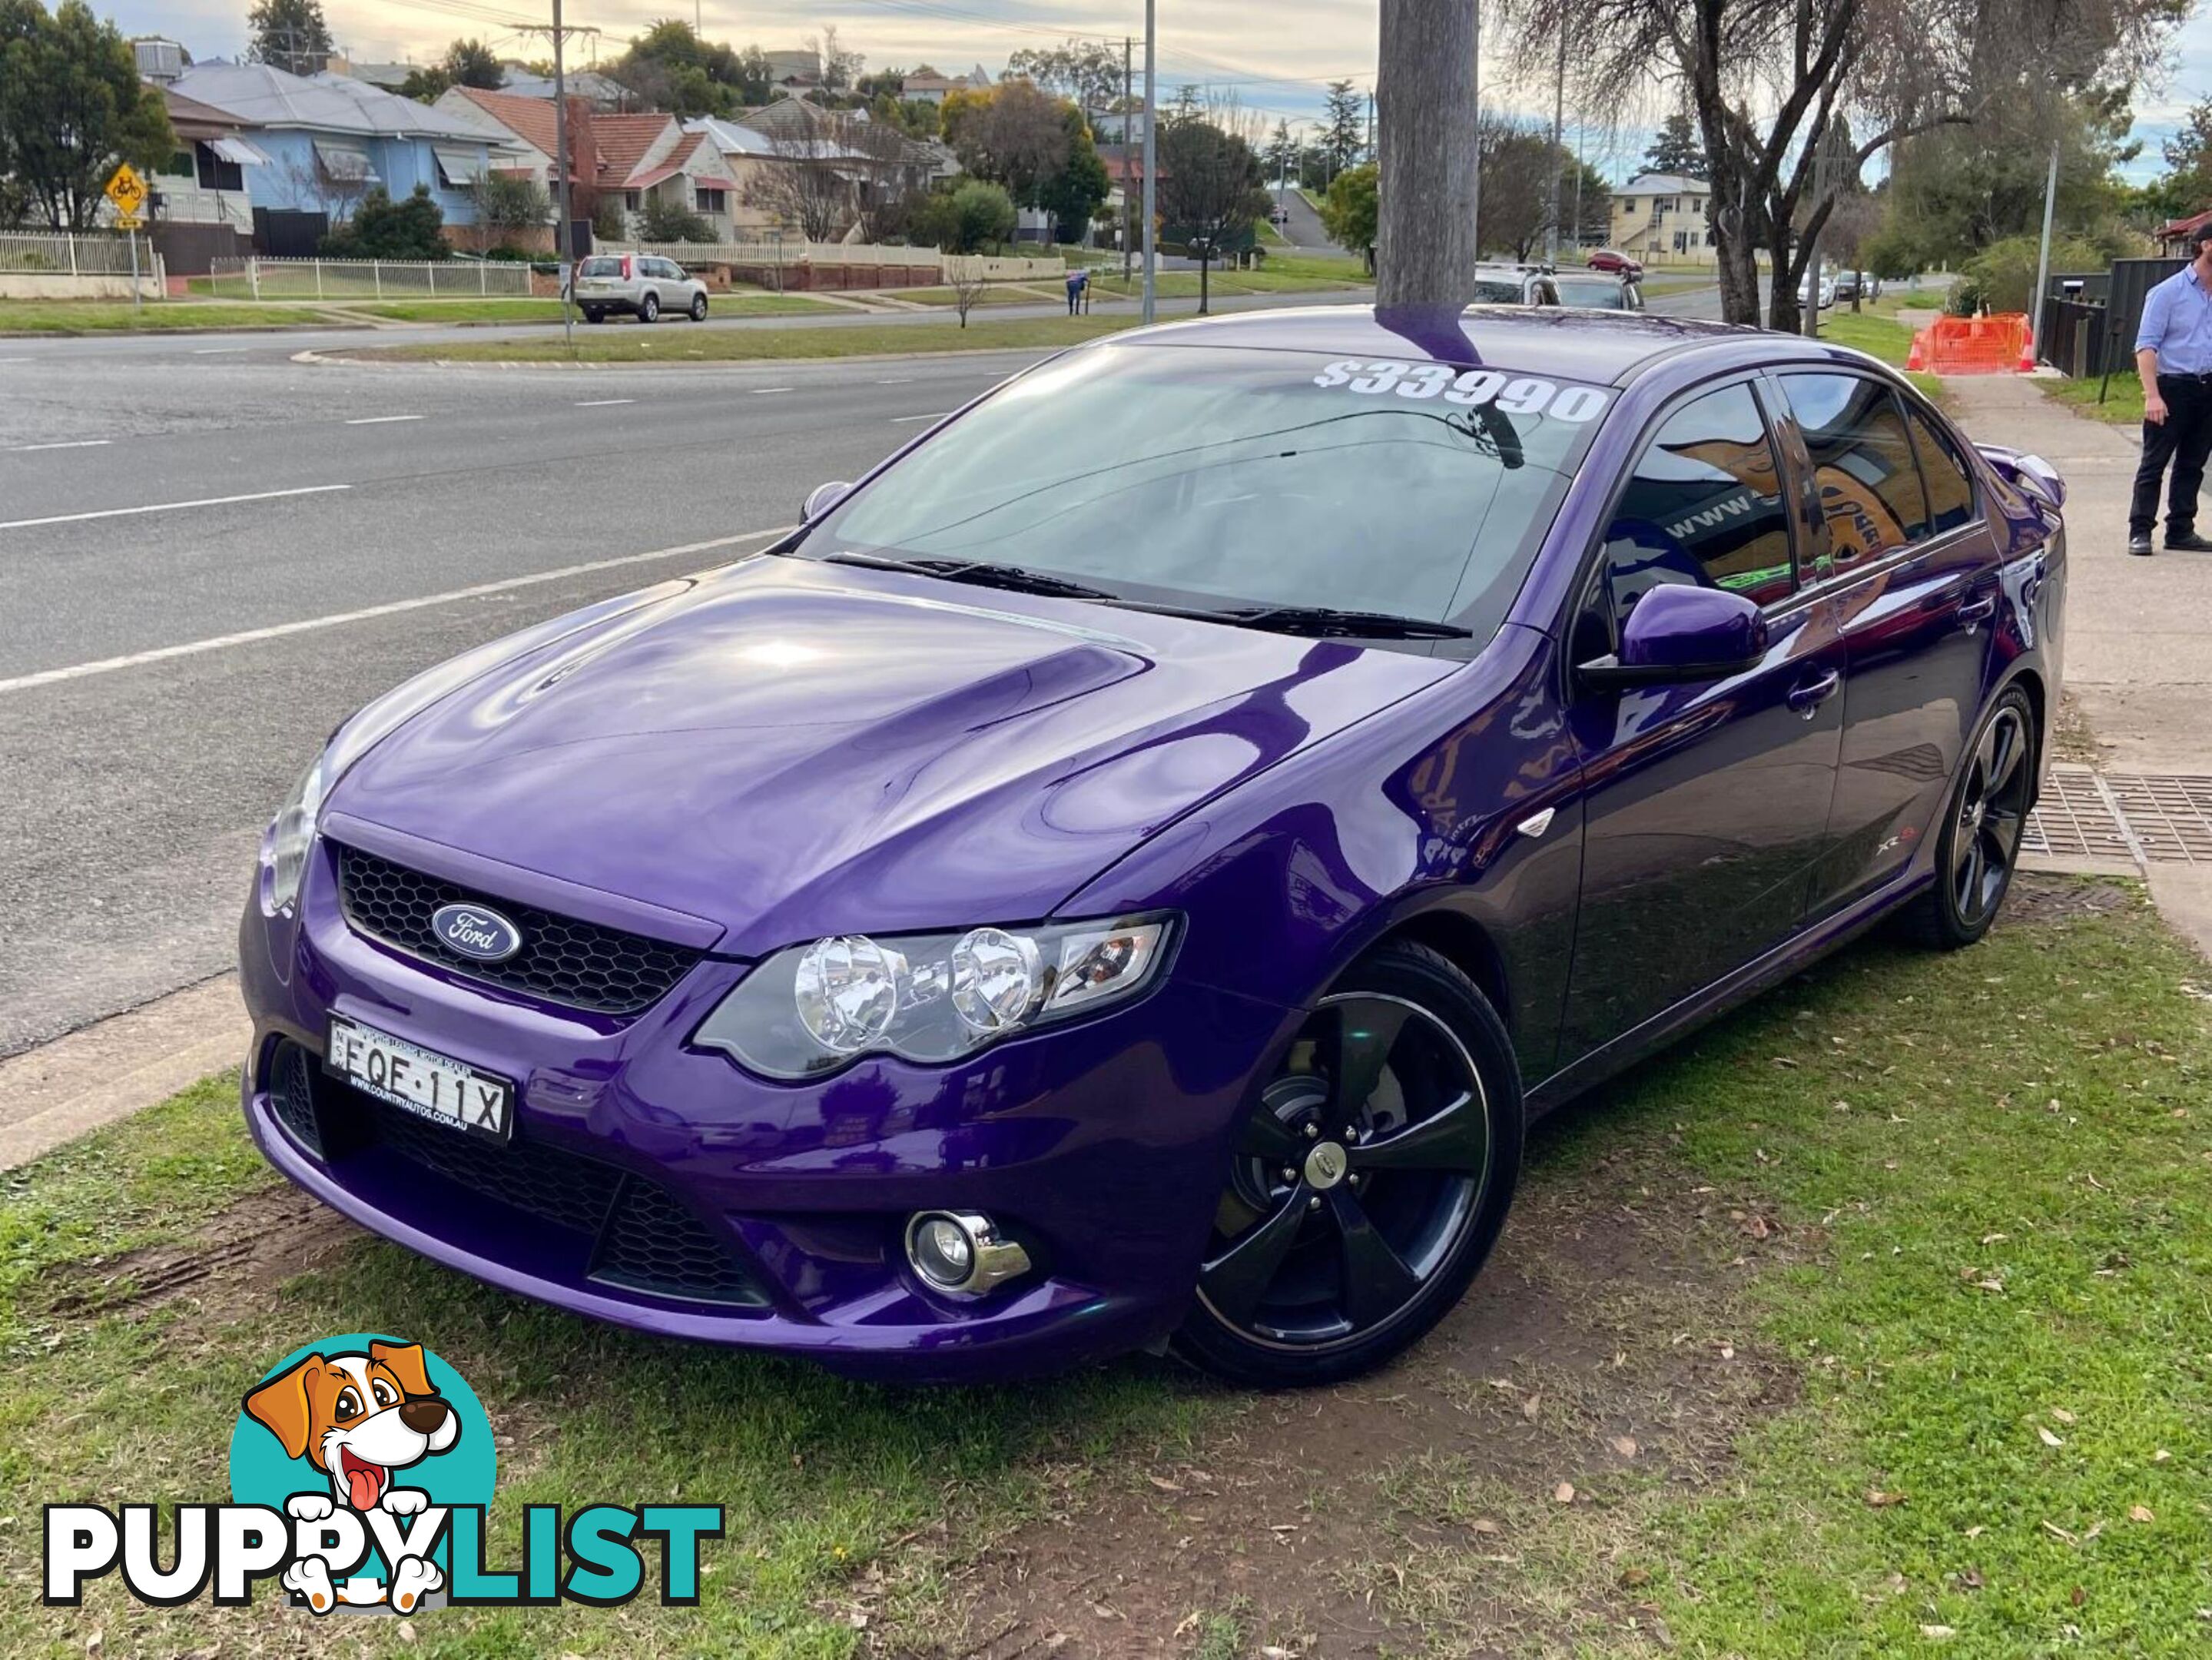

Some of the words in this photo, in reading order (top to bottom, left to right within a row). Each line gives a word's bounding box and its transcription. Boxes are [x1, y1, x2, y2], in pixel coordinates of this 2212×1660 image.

[1313, 360, 1609, 422] $33990
[448, 912, 499, 949] Ford
[350, 1074, 467, 1130] WWW.COUNTRYAUTOS.COM.AU
